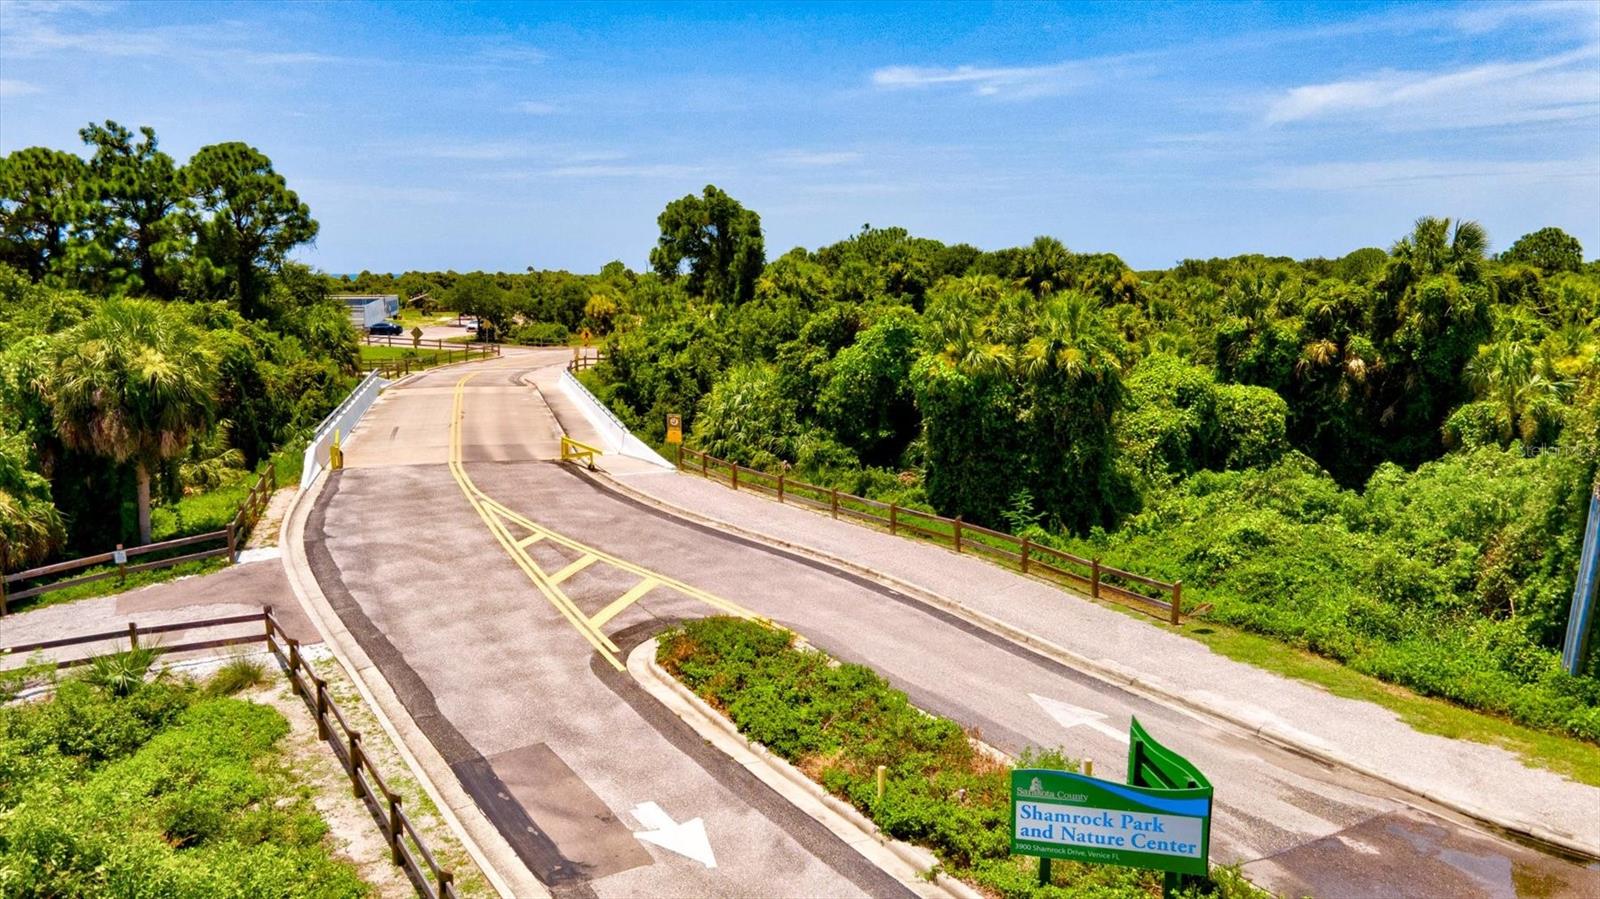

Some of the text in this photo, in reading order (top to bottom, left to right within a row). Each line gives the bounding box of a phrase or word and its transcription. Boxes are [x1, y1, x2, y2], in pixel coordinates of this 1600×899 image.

[1057, 791, 1089, 802] County
[1020, 804, 1165, 833] Shamrock Park
[1020, 824, 1197, 854] and Nature Center
[1015, 843, 1032, 851] 3900
[1033, 845, 1066, 855] Shamrock
[1087, 850, 1111, 859] Venice
